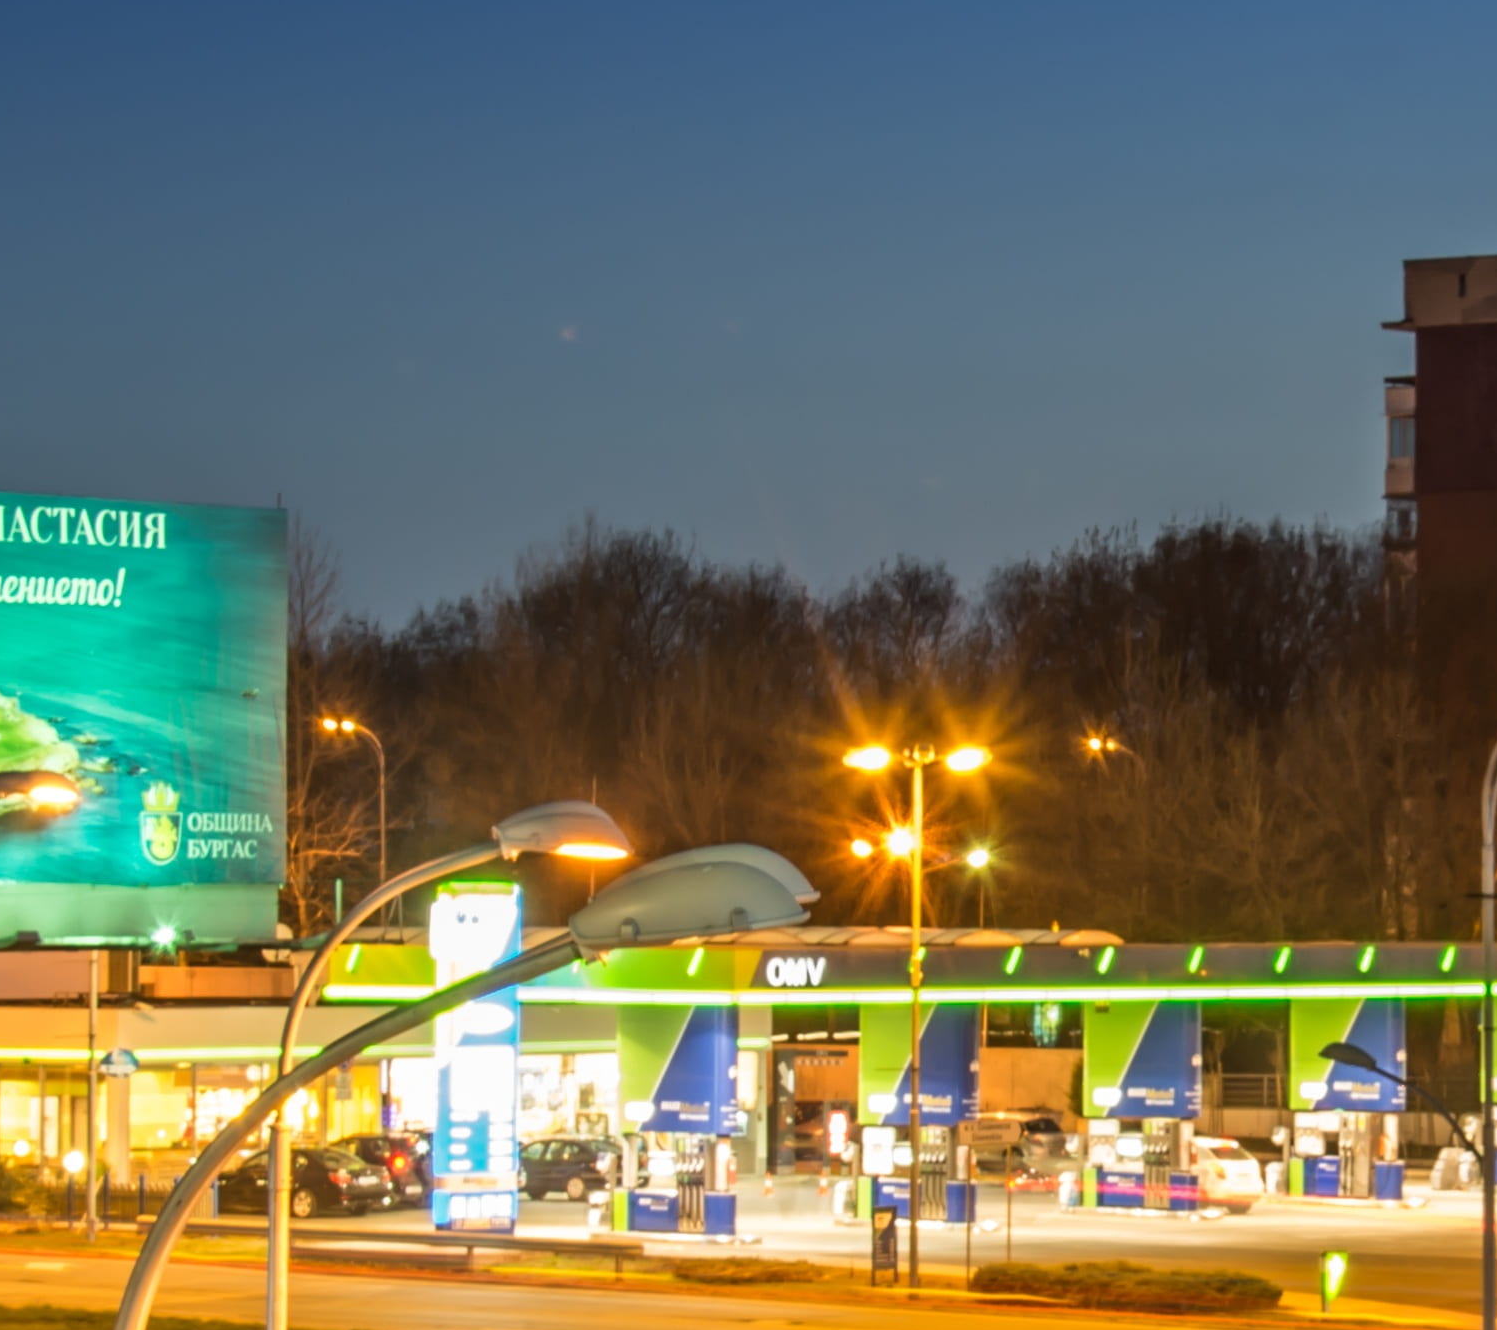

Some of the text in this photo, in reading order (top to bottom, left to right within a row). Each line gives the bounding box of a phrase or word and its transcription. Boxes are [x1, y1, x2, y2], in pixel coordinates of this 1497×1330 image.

[186, 811, 274, 835] ОБЩИНА
[186, 838, 258, 860] БУРГАС
[765, 956, 827, 988] OMV
